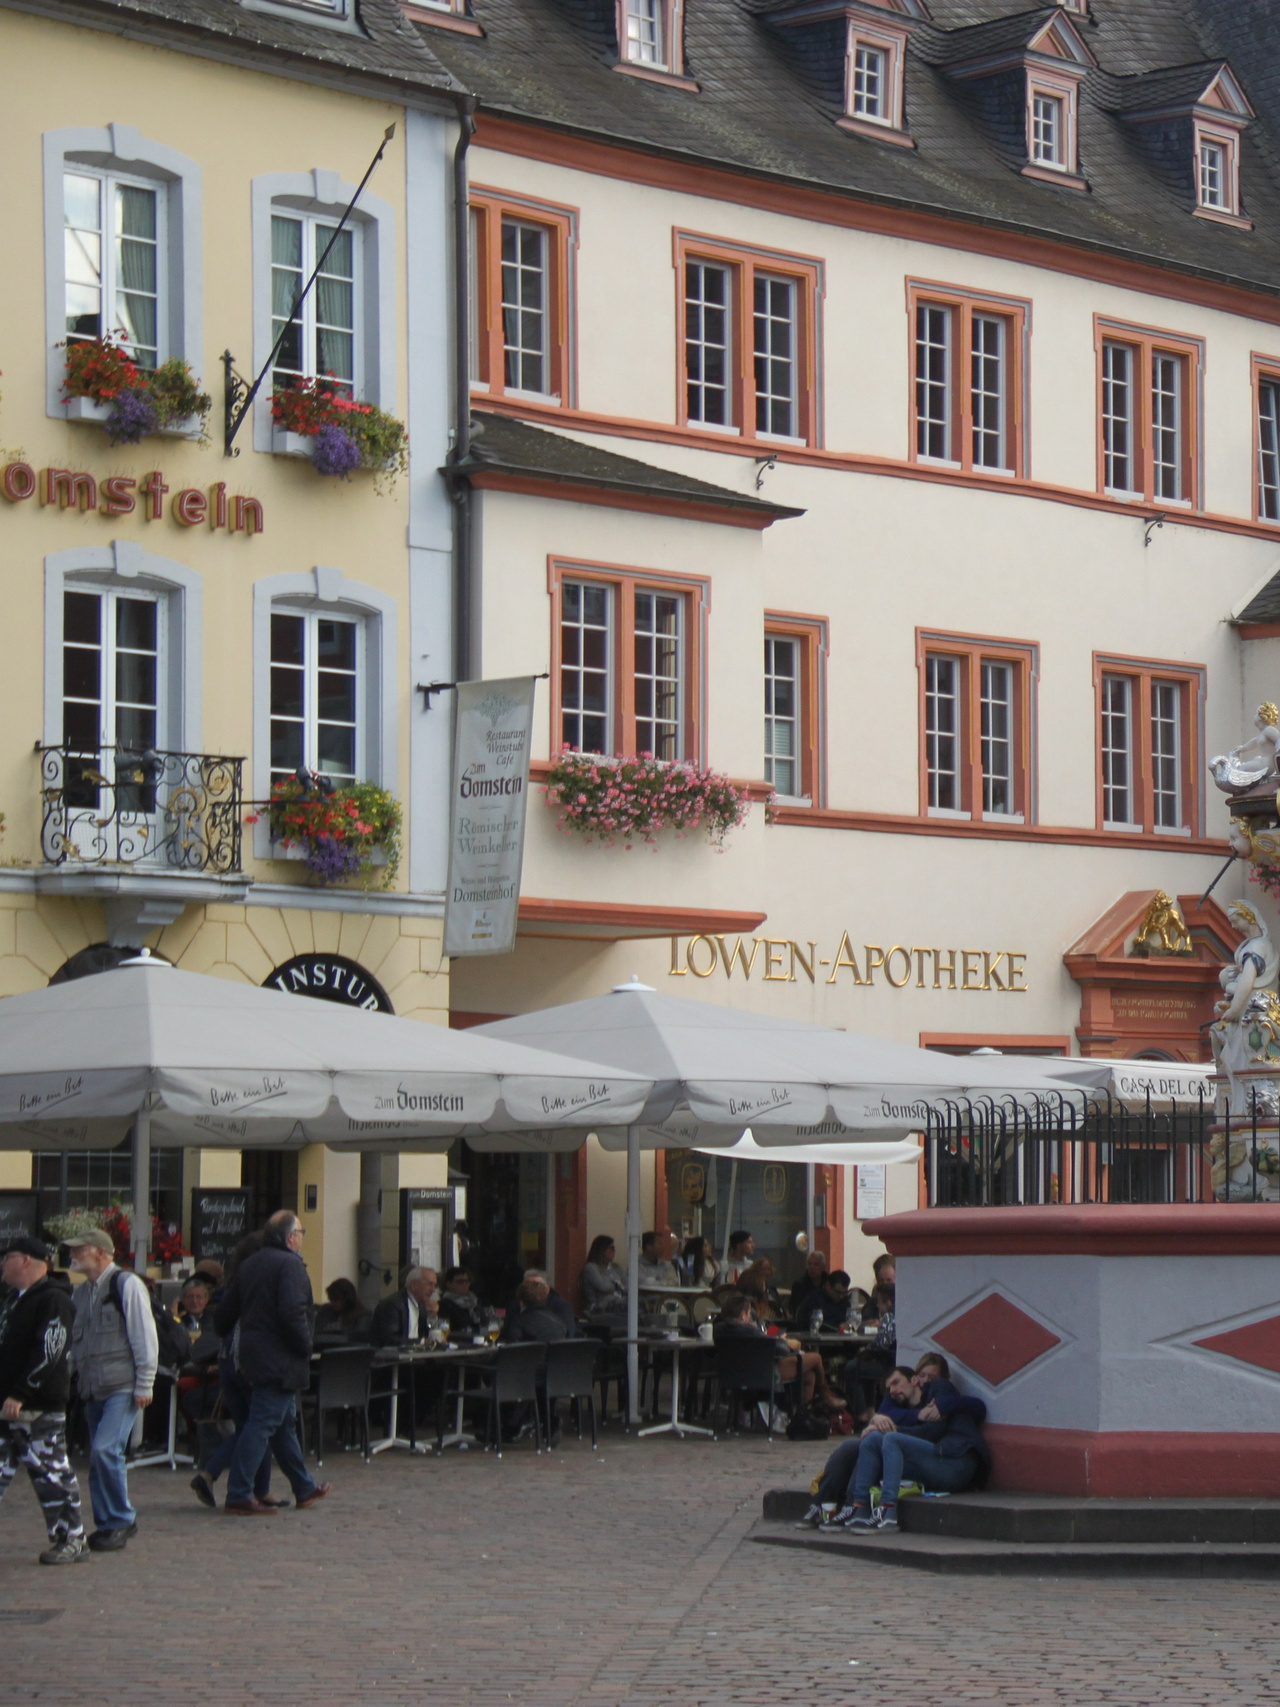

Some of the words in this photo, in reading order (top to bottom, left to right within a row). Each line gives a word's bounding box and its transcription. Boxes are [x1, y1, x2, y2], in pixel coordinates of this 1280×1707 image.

[486, 730, 526, 741] Restaurant
[487, 741, 525, 753] Weinstube
[461, 768, 522, 798] Domstein
[459, 815, 518, 835] Römischer
[453, 883, 515, 903] Domsteinhof
[1120, 1077, 1157, 1095] CASA
[1160, 1079, 1185, 1095] DEL
[396, 1081, 464, 1112] Domstein
[541, 1096, 567, 1113] Bitte
[589, 1084, 609, 1099] Bit
[729, 1098, 753, 1115] Bitte
[771, 1088, 789, 1102] Bit
[881, 1093, 937, 1119] Domsten
[420, 1189, 453, 1199] Domstein
